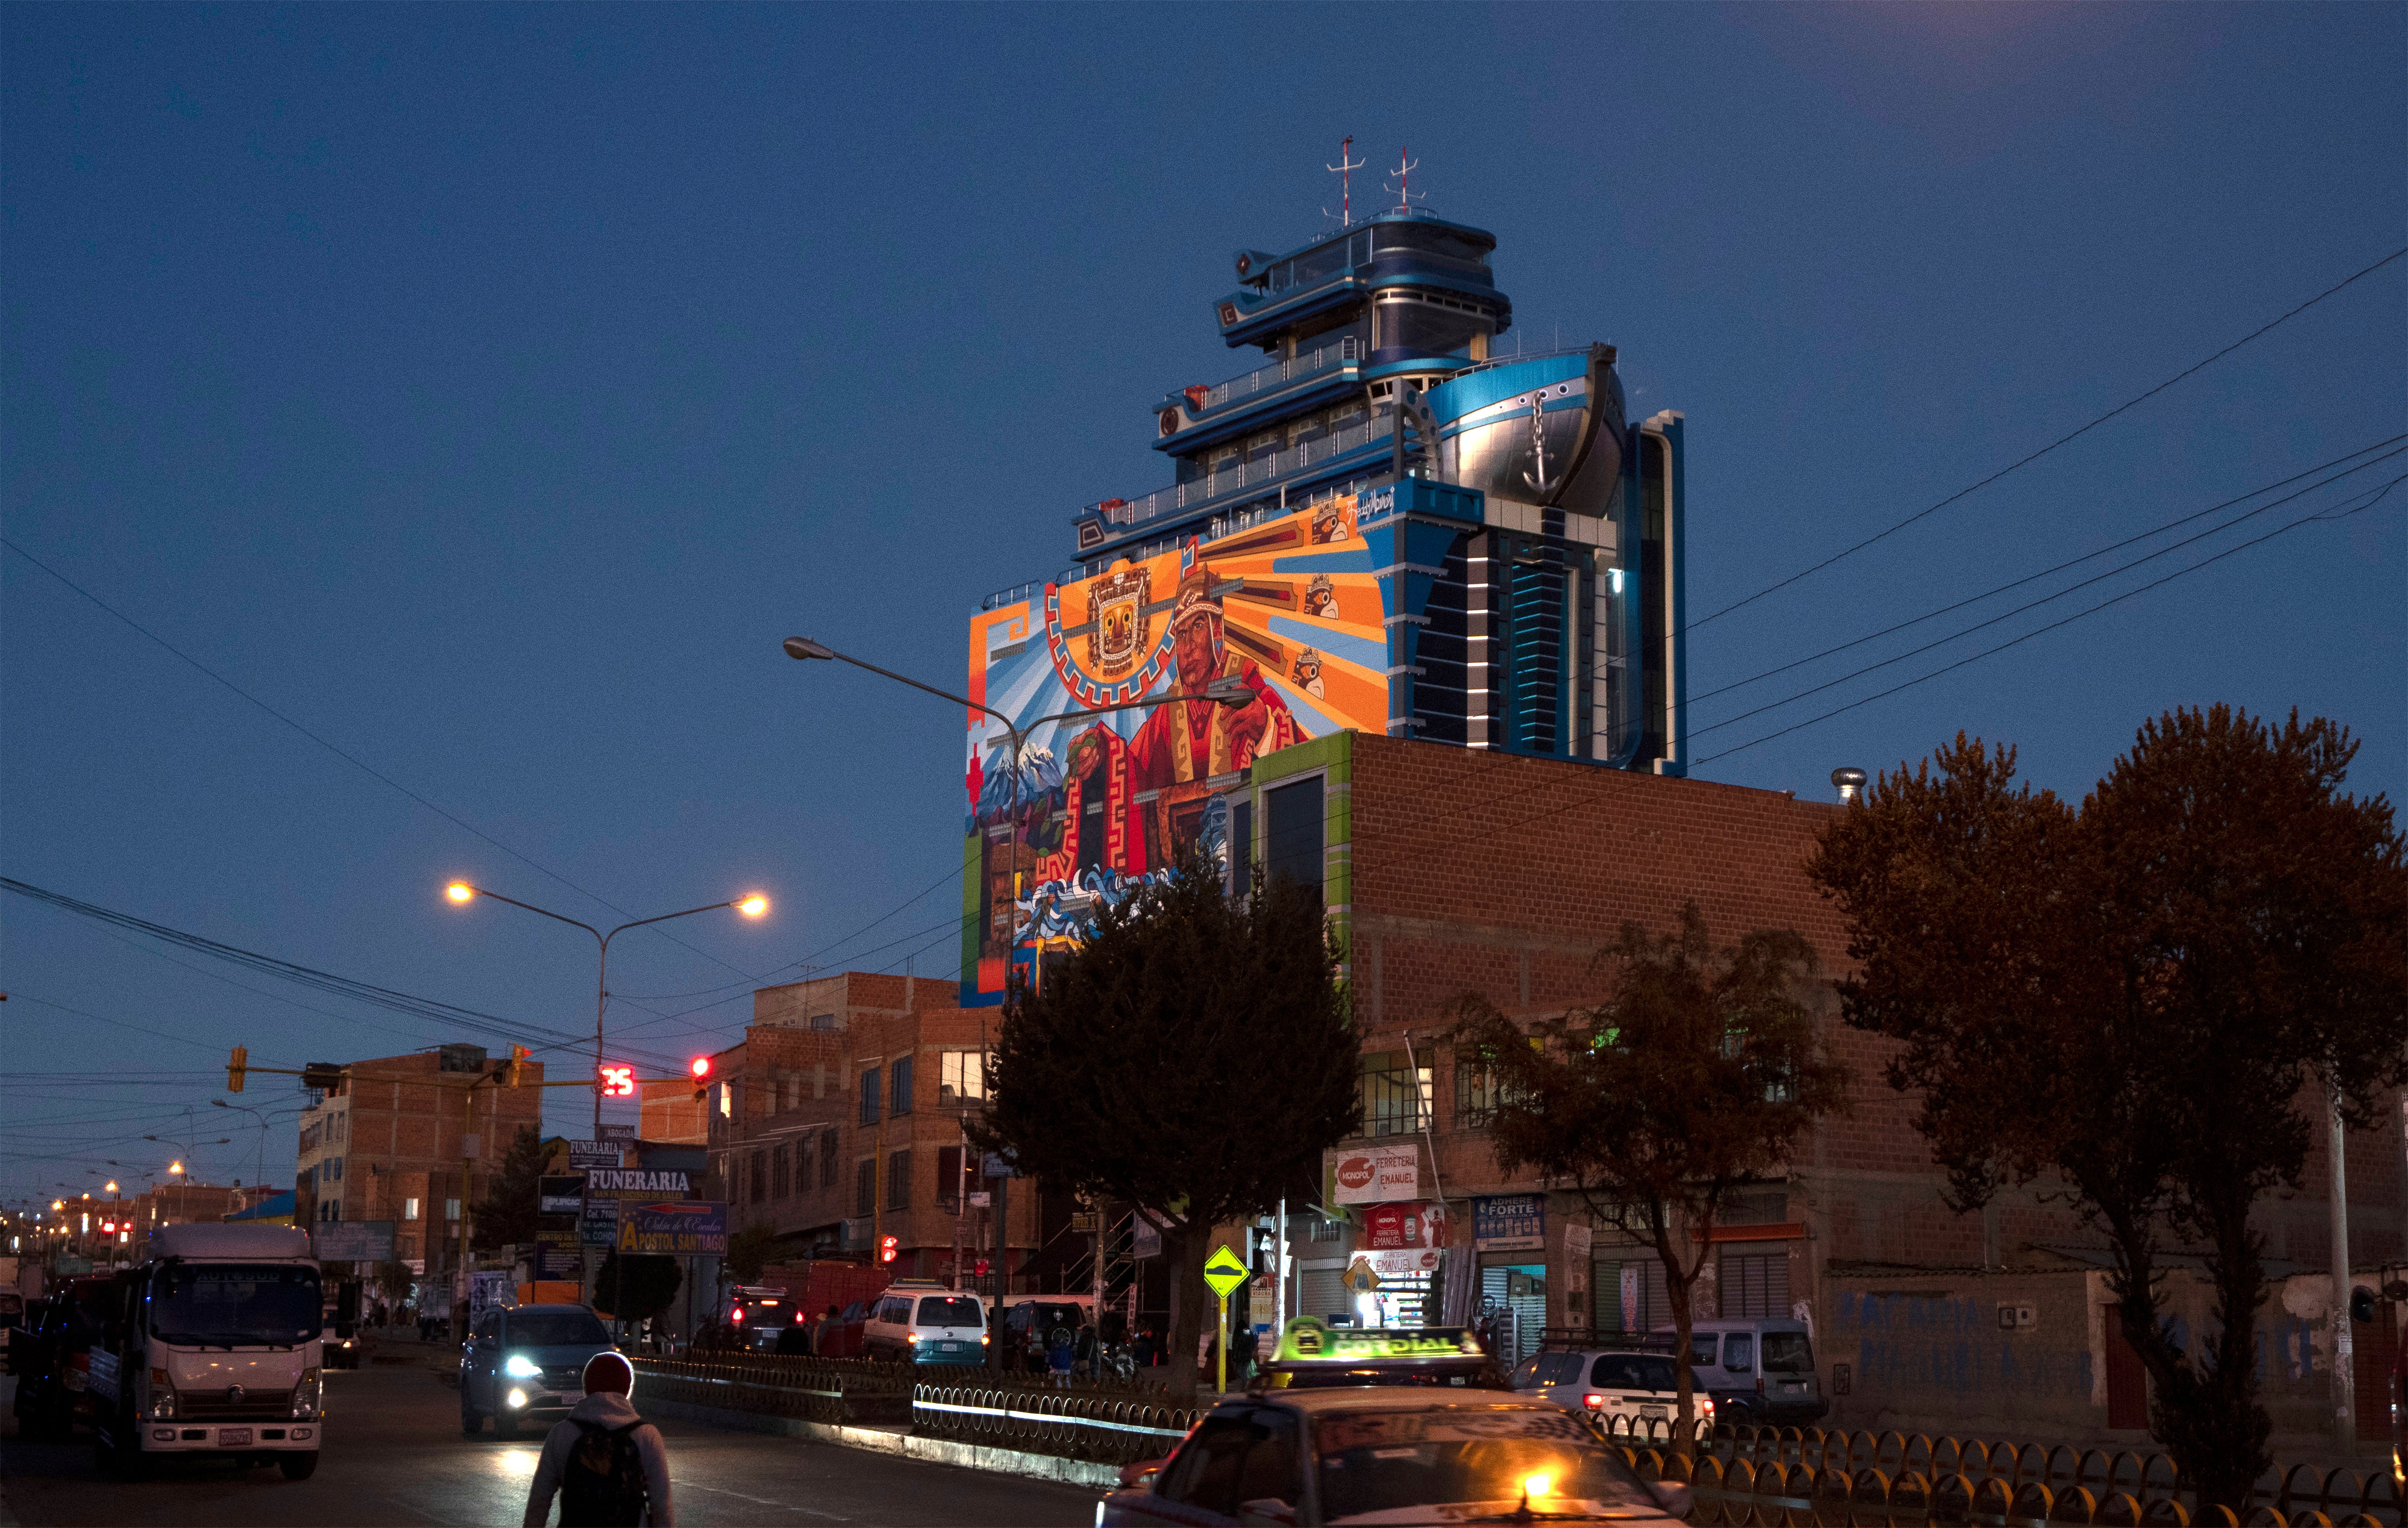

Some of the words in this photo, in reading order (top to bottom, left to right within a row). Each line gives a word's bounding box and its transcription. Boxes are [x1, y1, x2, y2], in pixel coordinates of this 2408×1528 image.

[607, 1129, 634, 1137] ABOGADA
[570, 1141, 618, 1155] FUNERARIA
[589, 1170, 689, 1191] FUNERARIA
[1342, 1171, 1370, 1179] MONOPOL
[1381, 1173, 1414, 1184] EMANUEL
[1491, 1196, 1533, 1205] ADHERE
[587, 1209, 598, 1219] Cel.
[1489, 1204, 1534, 1215] FORTE
[620, 1222, 675, 1251] APOSTOL
[677, 1234, 725, 1251] SANTIAGO
[1373, 1237, 1402, 1246] EMANUEL
[1376, 1259, 1413, 1271] EMANUEL
